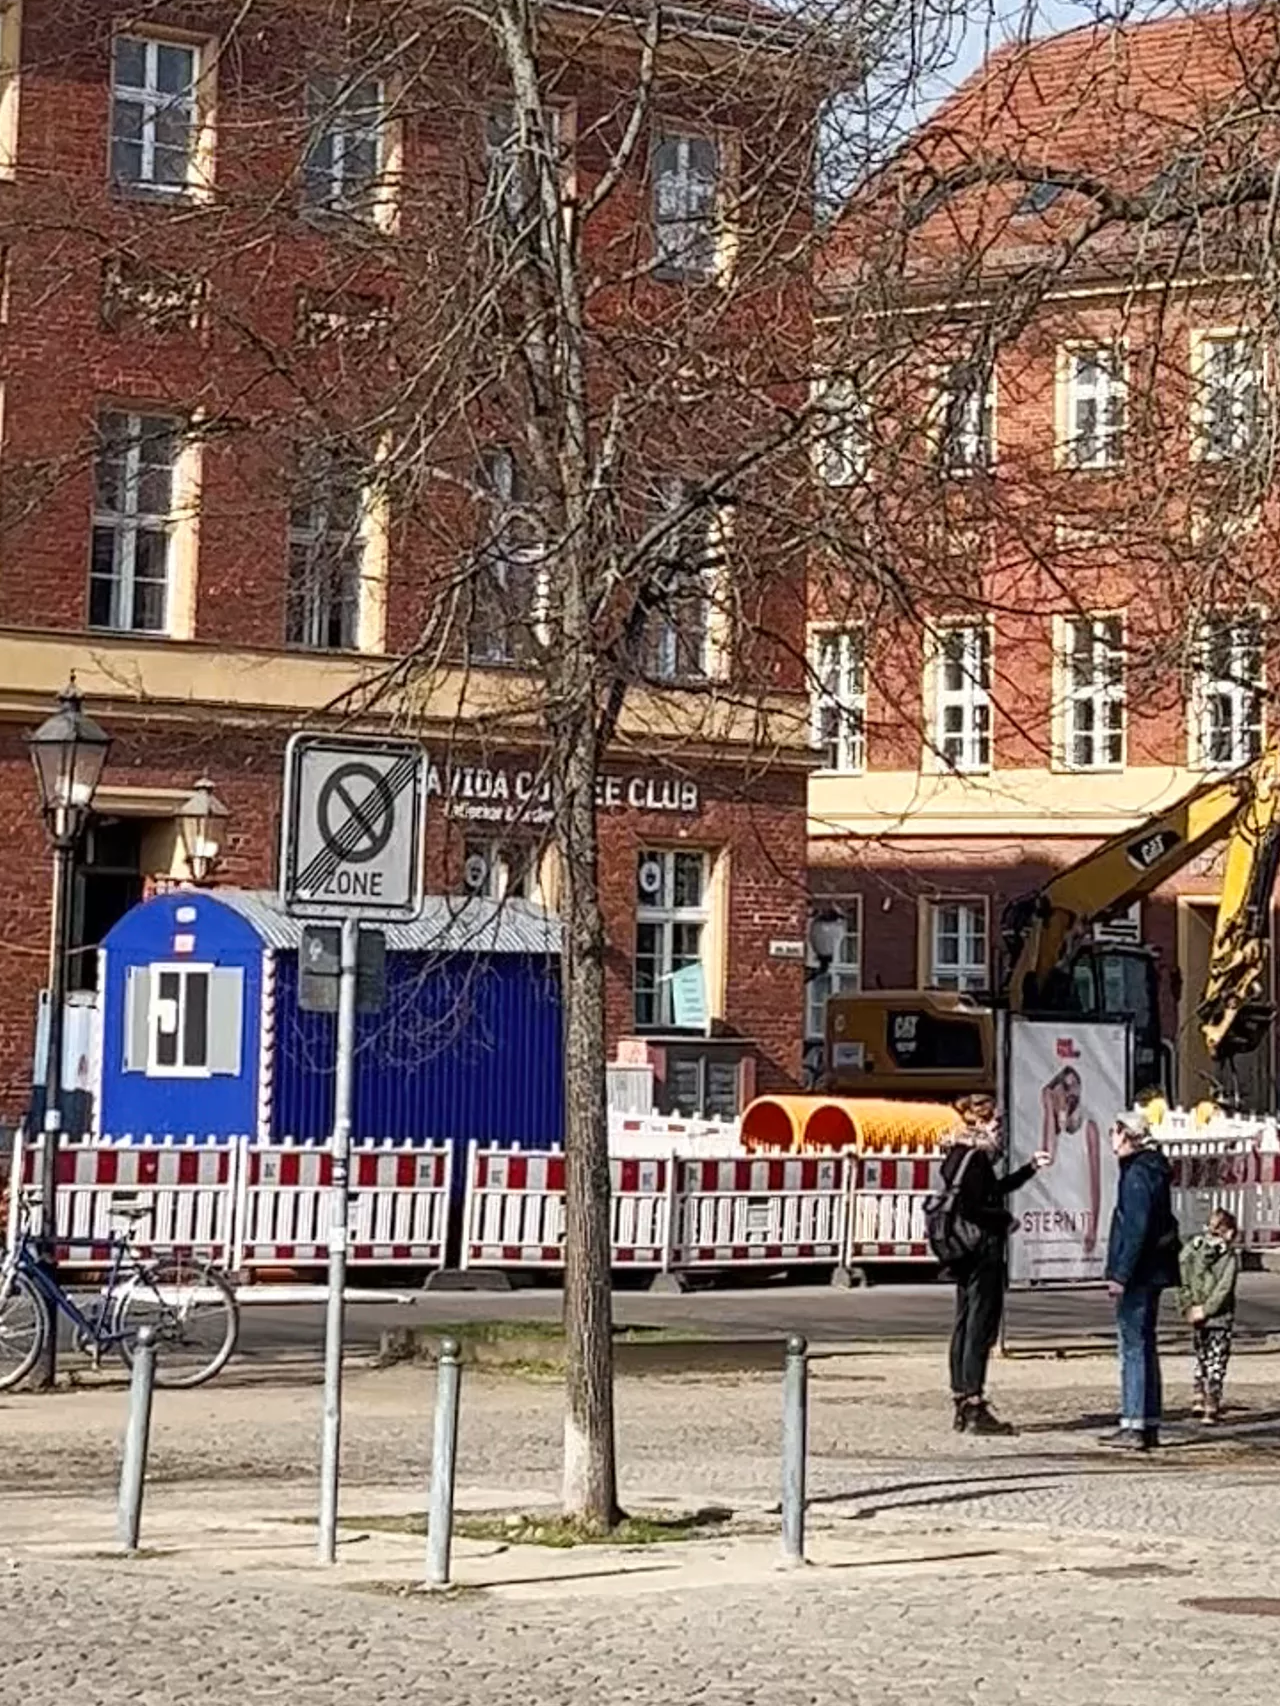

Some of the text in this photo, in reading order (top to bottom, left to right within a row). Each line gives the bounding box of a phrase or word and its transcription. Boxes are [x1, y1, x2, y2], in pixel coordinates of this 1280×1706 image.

[516, 772, 623, 805] COEE
[629, 778, 698, 811] CLUB
[323, 870, 384, 897] ZONE
[1023, 1211, 1076, 1233] STERN
